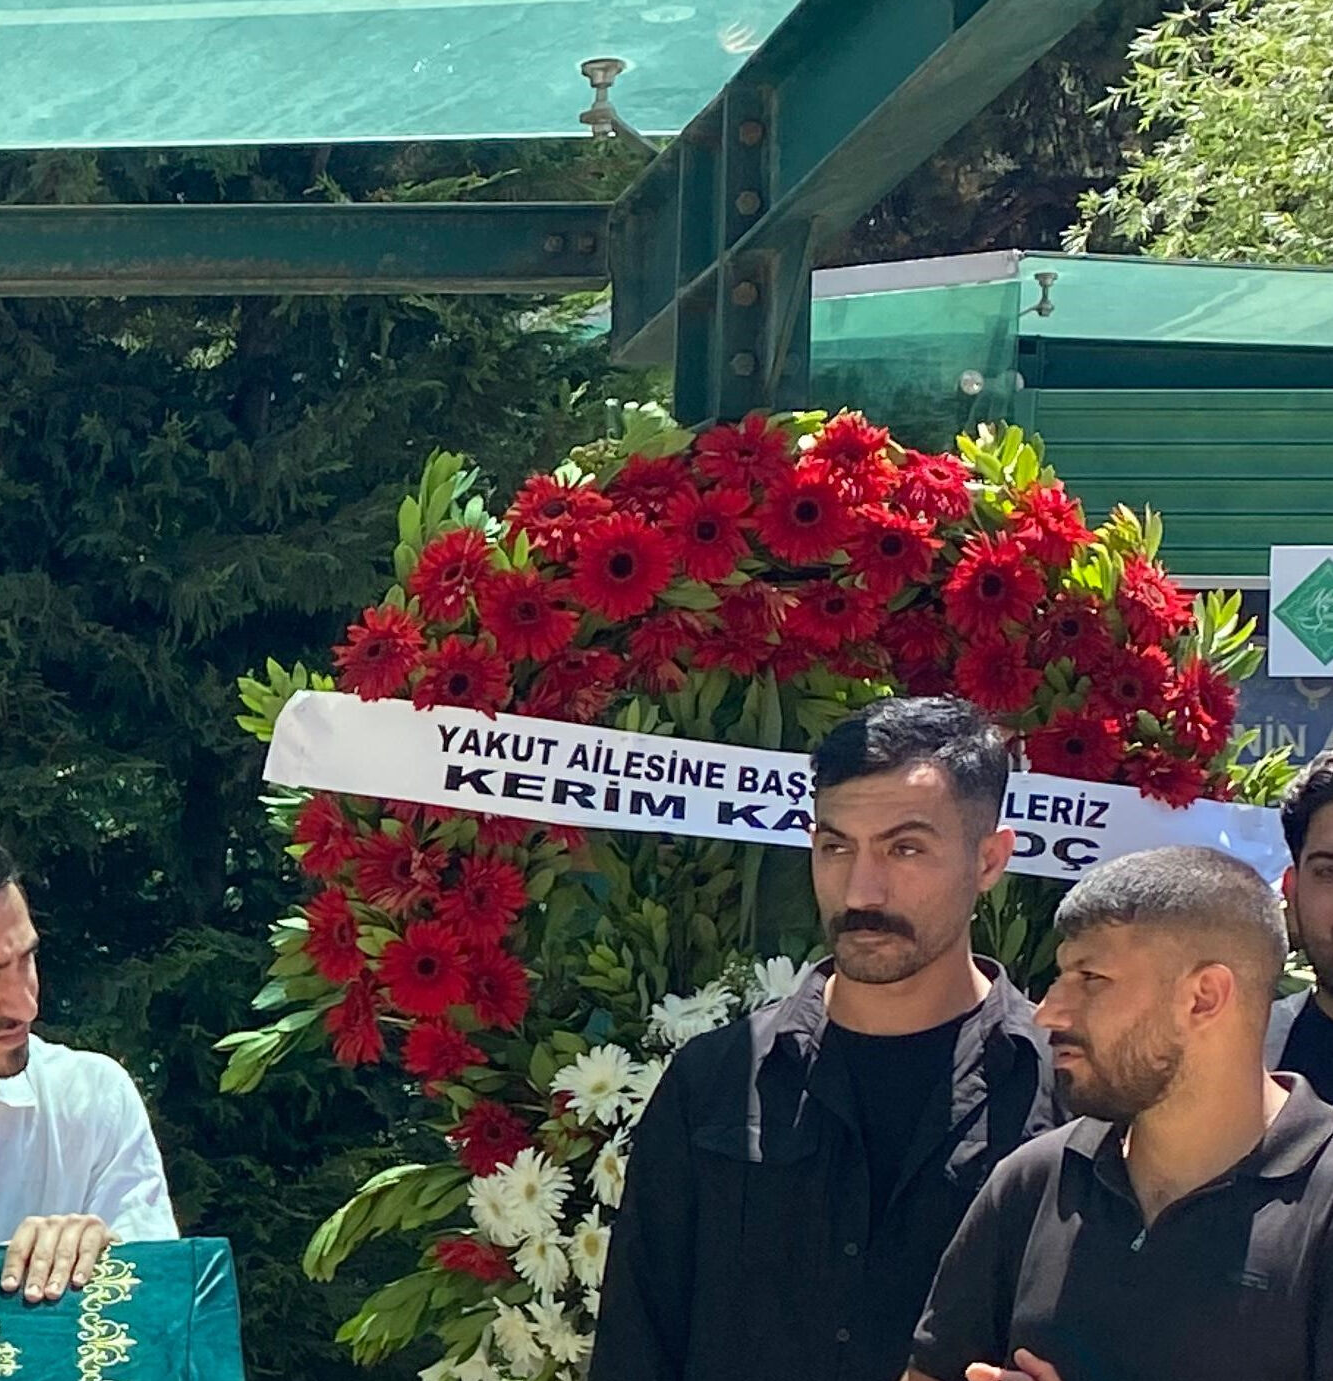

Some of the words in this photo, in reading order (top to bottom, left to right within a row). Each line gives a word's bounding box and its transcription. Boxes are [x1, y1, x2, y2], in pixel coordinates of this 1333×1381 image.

[1233, 716, 1307, 758] NİN
[437, 724, 558, 765] YAKUT
[567, 739, 726, 790] AİLESİNE
[1004, 792, 1110, 829] LERİZ
[444, 765, 687, 821] KERİM
